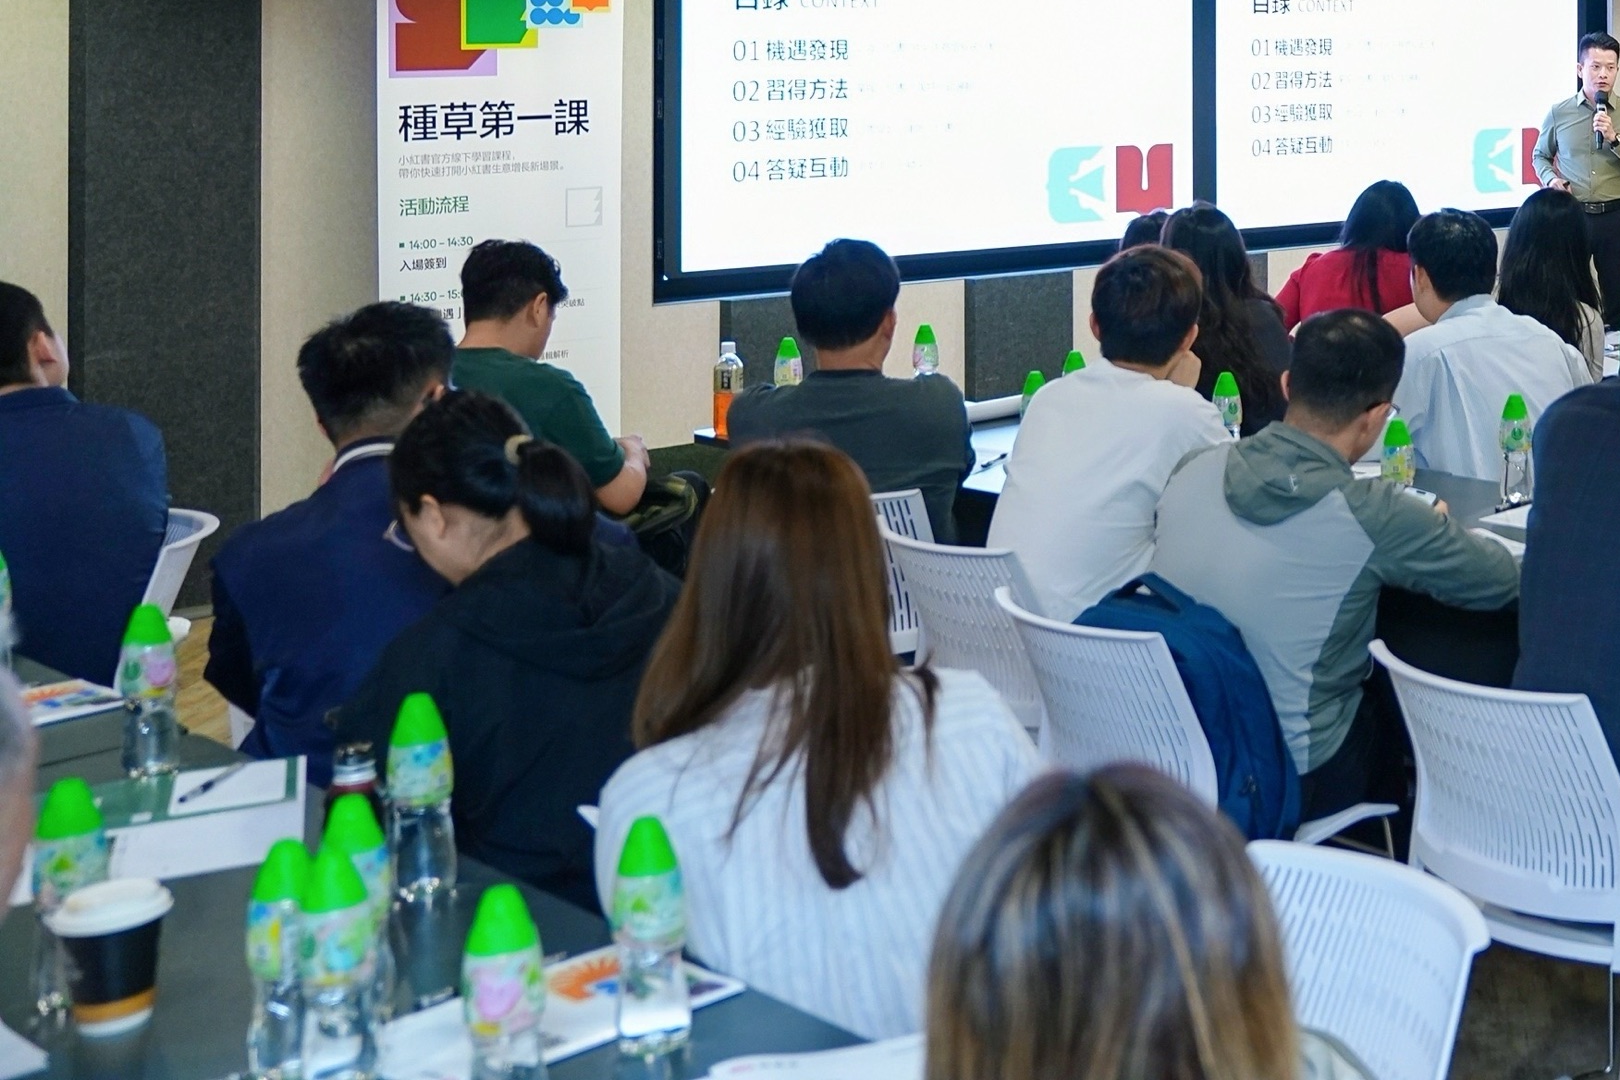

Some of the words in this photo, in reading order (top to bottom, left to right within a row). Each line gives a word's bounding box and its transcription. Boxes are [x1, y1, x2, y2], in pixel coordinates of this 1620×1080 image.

[1298, 0, 1353, 13] CONTEXT
[733, 40, 760, 61] 01
[766, 39, 849, 61] 機遇發現
[1251, 39, 1270, 56] 01
[733, 80, 760, 102] 02
[766, 78, 849, 101] 習得方法
[1251, 72, 1270, 90] 02
[398, 99, 590, 142] 種草第一課
[1251, 106, 1270, 123] 03
[733, 120, 760, 142] 03
[766, 118, 849, 141] 經驗獲取
[1251, 139, 1270, 157] 04
[733, 161, 760, 182] 04
[766, 156, 849, 181] 答疑互動
[399, 195, 470, 217] 活動流程
[409, 239, 437, 250] 14:00
[447, 236, 473, 247] 14:30
[410, 291, 437, 302] 14:30
[447, 289, 464, 300] 15:
